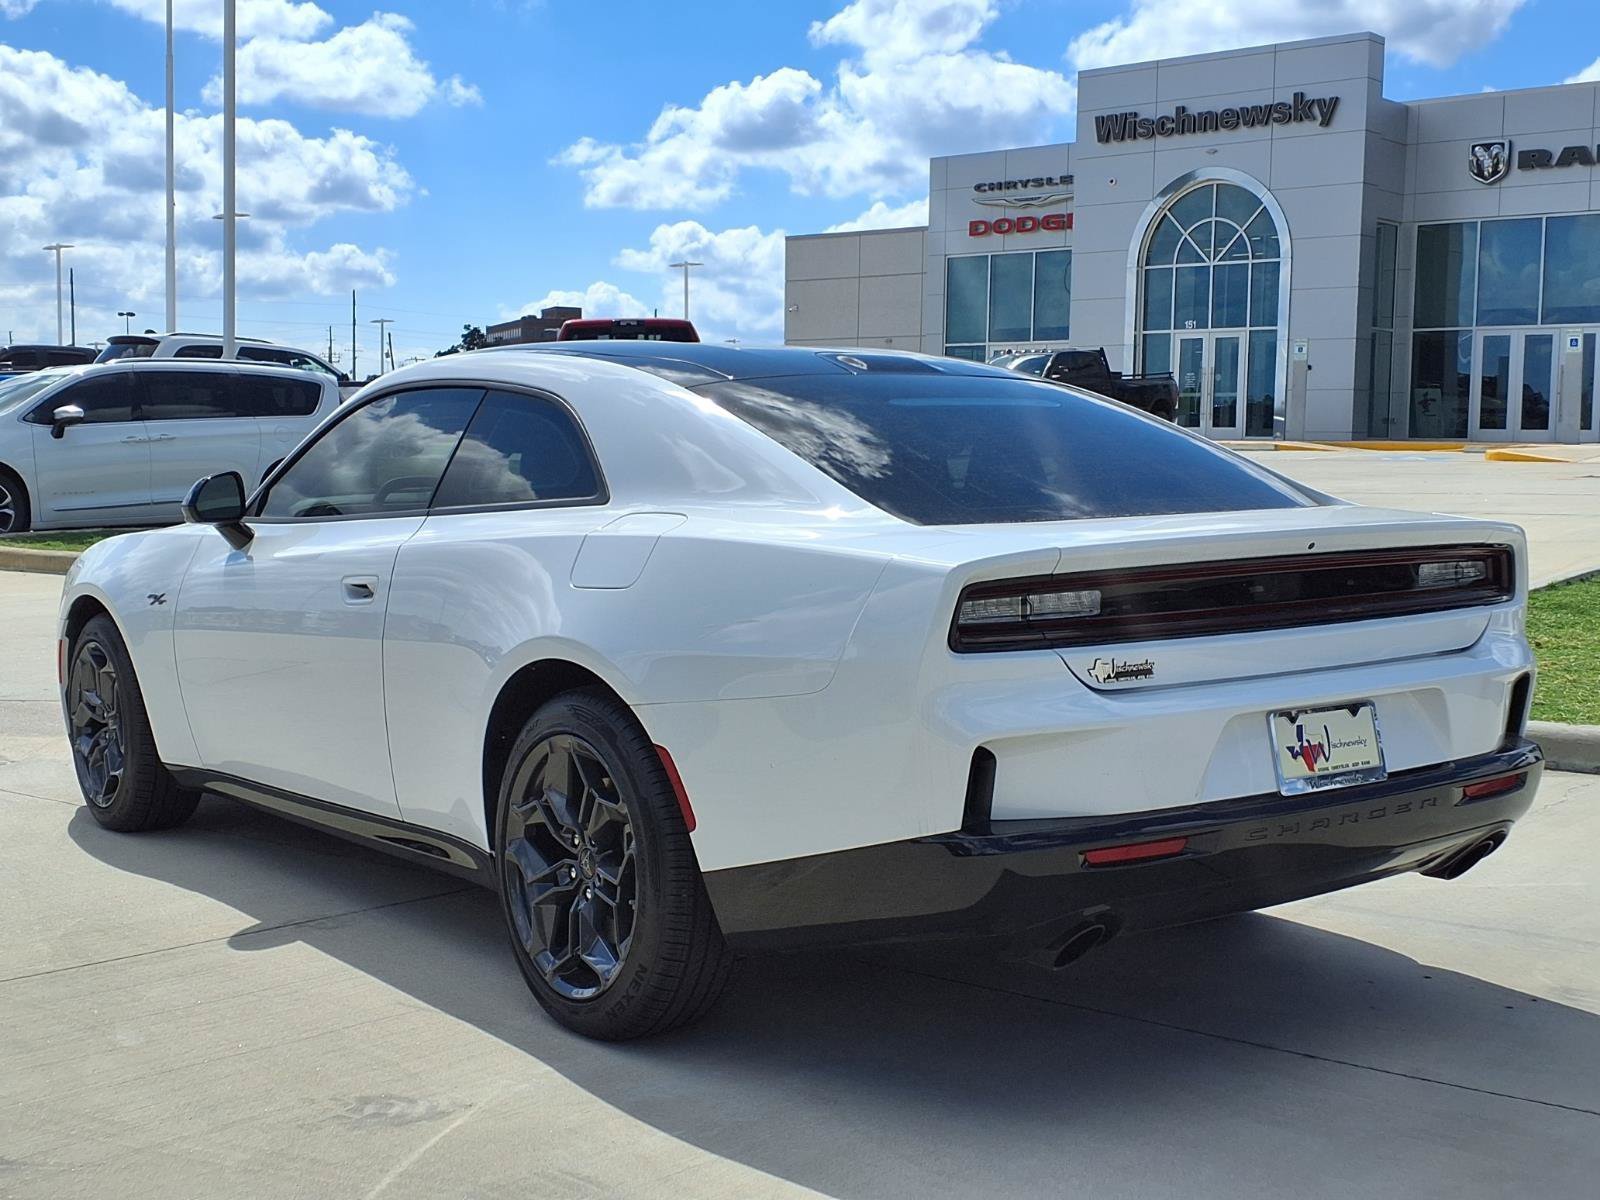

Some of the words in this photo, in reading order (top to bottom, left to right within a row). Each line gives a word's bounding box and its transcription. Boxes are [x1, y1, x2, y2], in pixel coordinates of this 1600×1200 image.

[1095, 91, 1340, 144] Wischnewsky
[1518, 144, 1600, 172] RA
[1184, 320, 1197, 329] 151
[1244, 797, 1439, 842] CHARGER
